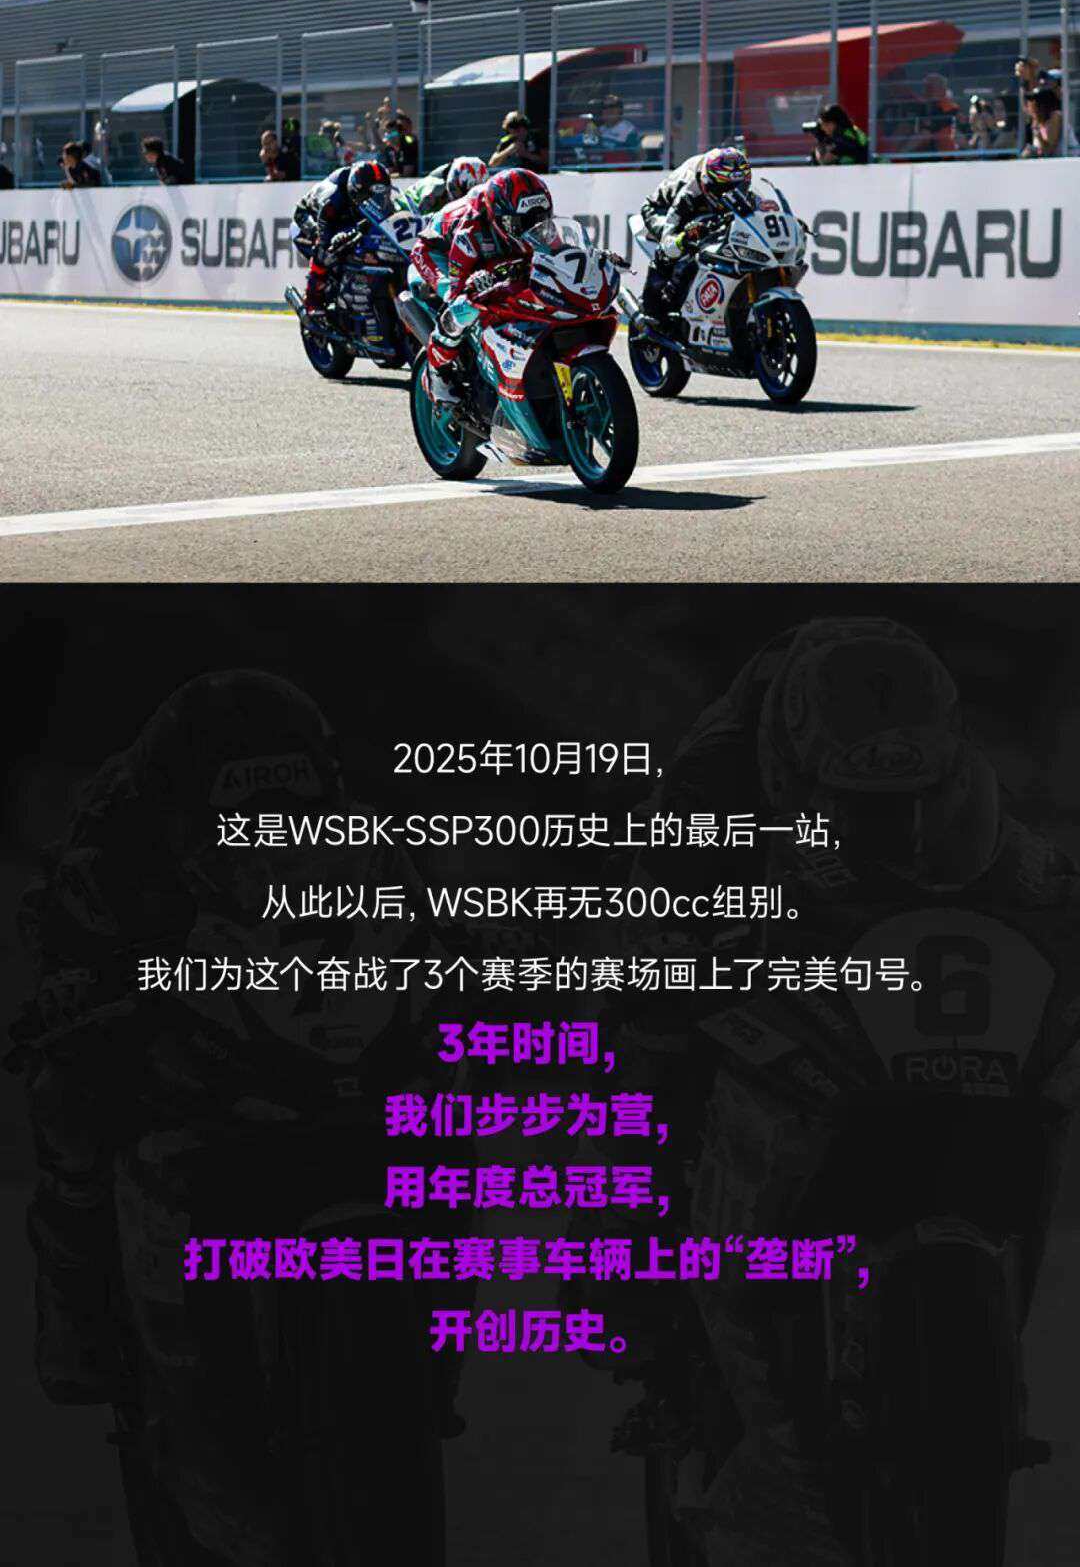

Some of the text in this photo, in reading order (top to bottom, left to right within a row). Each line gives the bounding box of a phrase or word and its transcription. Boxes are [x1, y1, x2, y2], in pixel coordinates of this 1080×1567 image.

[181, 218, 312, 268] SUBAR
[764, 214, 790, 238] 91
[811, 208, 1062, 279] SUBARU
[914, 934, 992, 1037] 6
